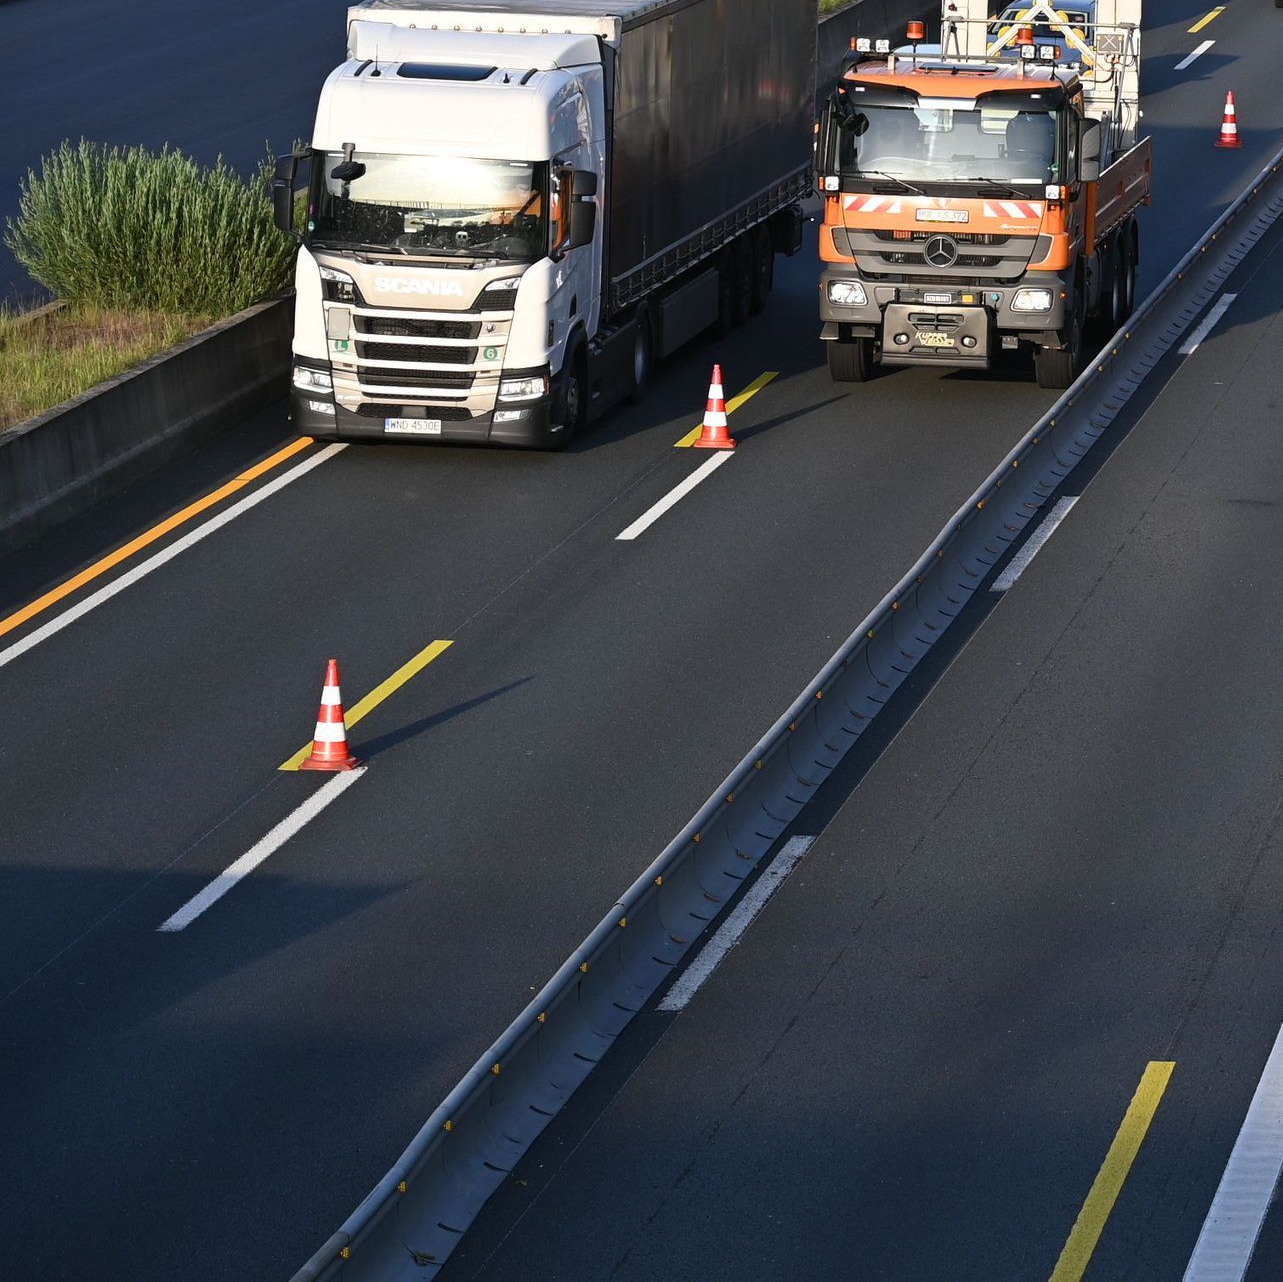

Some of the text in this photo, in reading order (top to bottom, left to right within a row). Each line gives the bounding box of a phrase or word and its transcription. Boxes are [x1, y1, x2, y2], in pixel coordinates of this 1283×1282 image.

[374, 276, 464, 296] SCANIA
[487, 348, 495, 359] 6
[390, 420, 440, 431] WND 4530E
